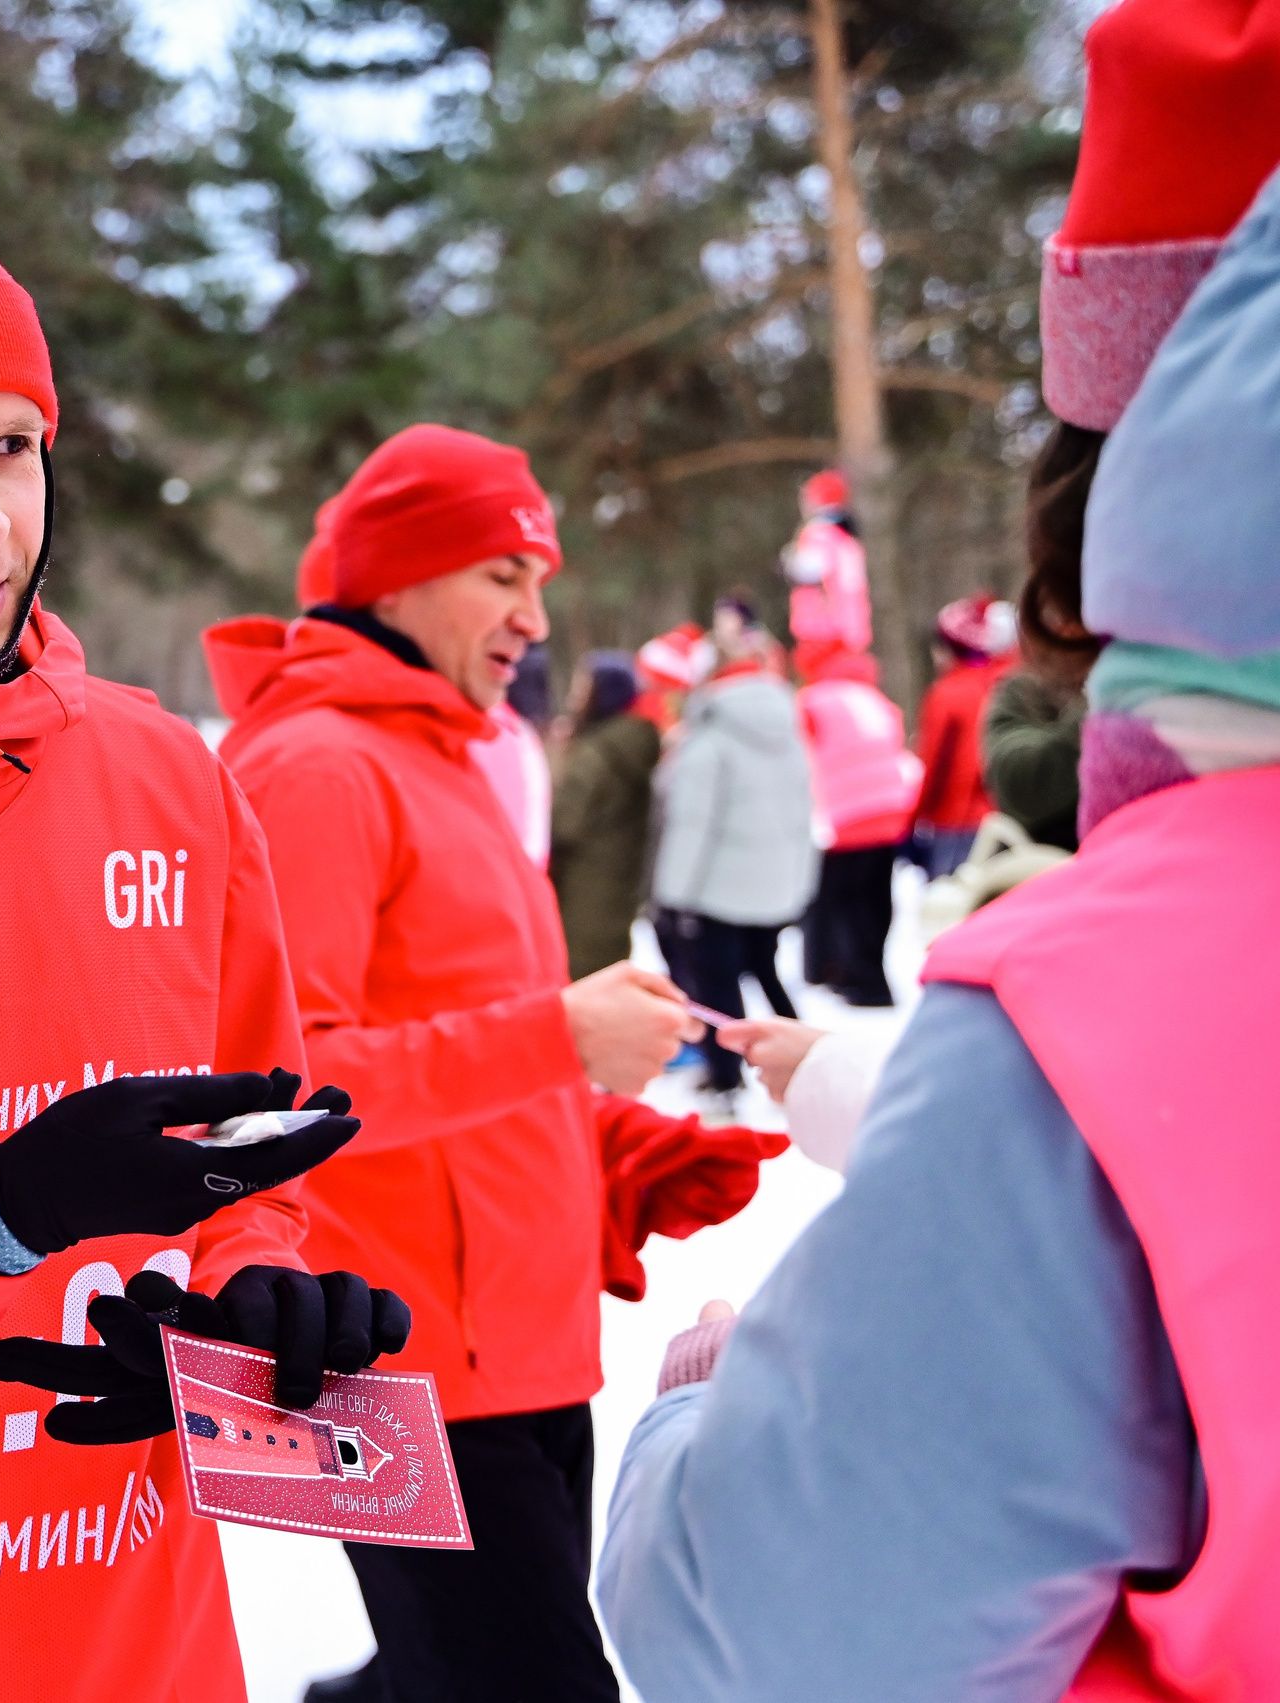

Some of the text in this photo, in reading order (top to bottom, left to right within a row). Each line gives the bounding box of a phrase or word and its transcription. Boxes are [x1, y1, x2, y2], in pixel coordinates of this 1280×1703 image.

[104, 849, 188, 929] GRi
[315, 1391, 345, 1411] ЩИТЕ
[347, 1394, 375, 1414] СВЕТ
[221, 1417, 238, 1444] GRi
[374, 1405, 413, 1440] ДАЖЕ
[403, 1444, 419, 1452] В
[330, 1491, 379, 1515] ВРЕМЕНА
